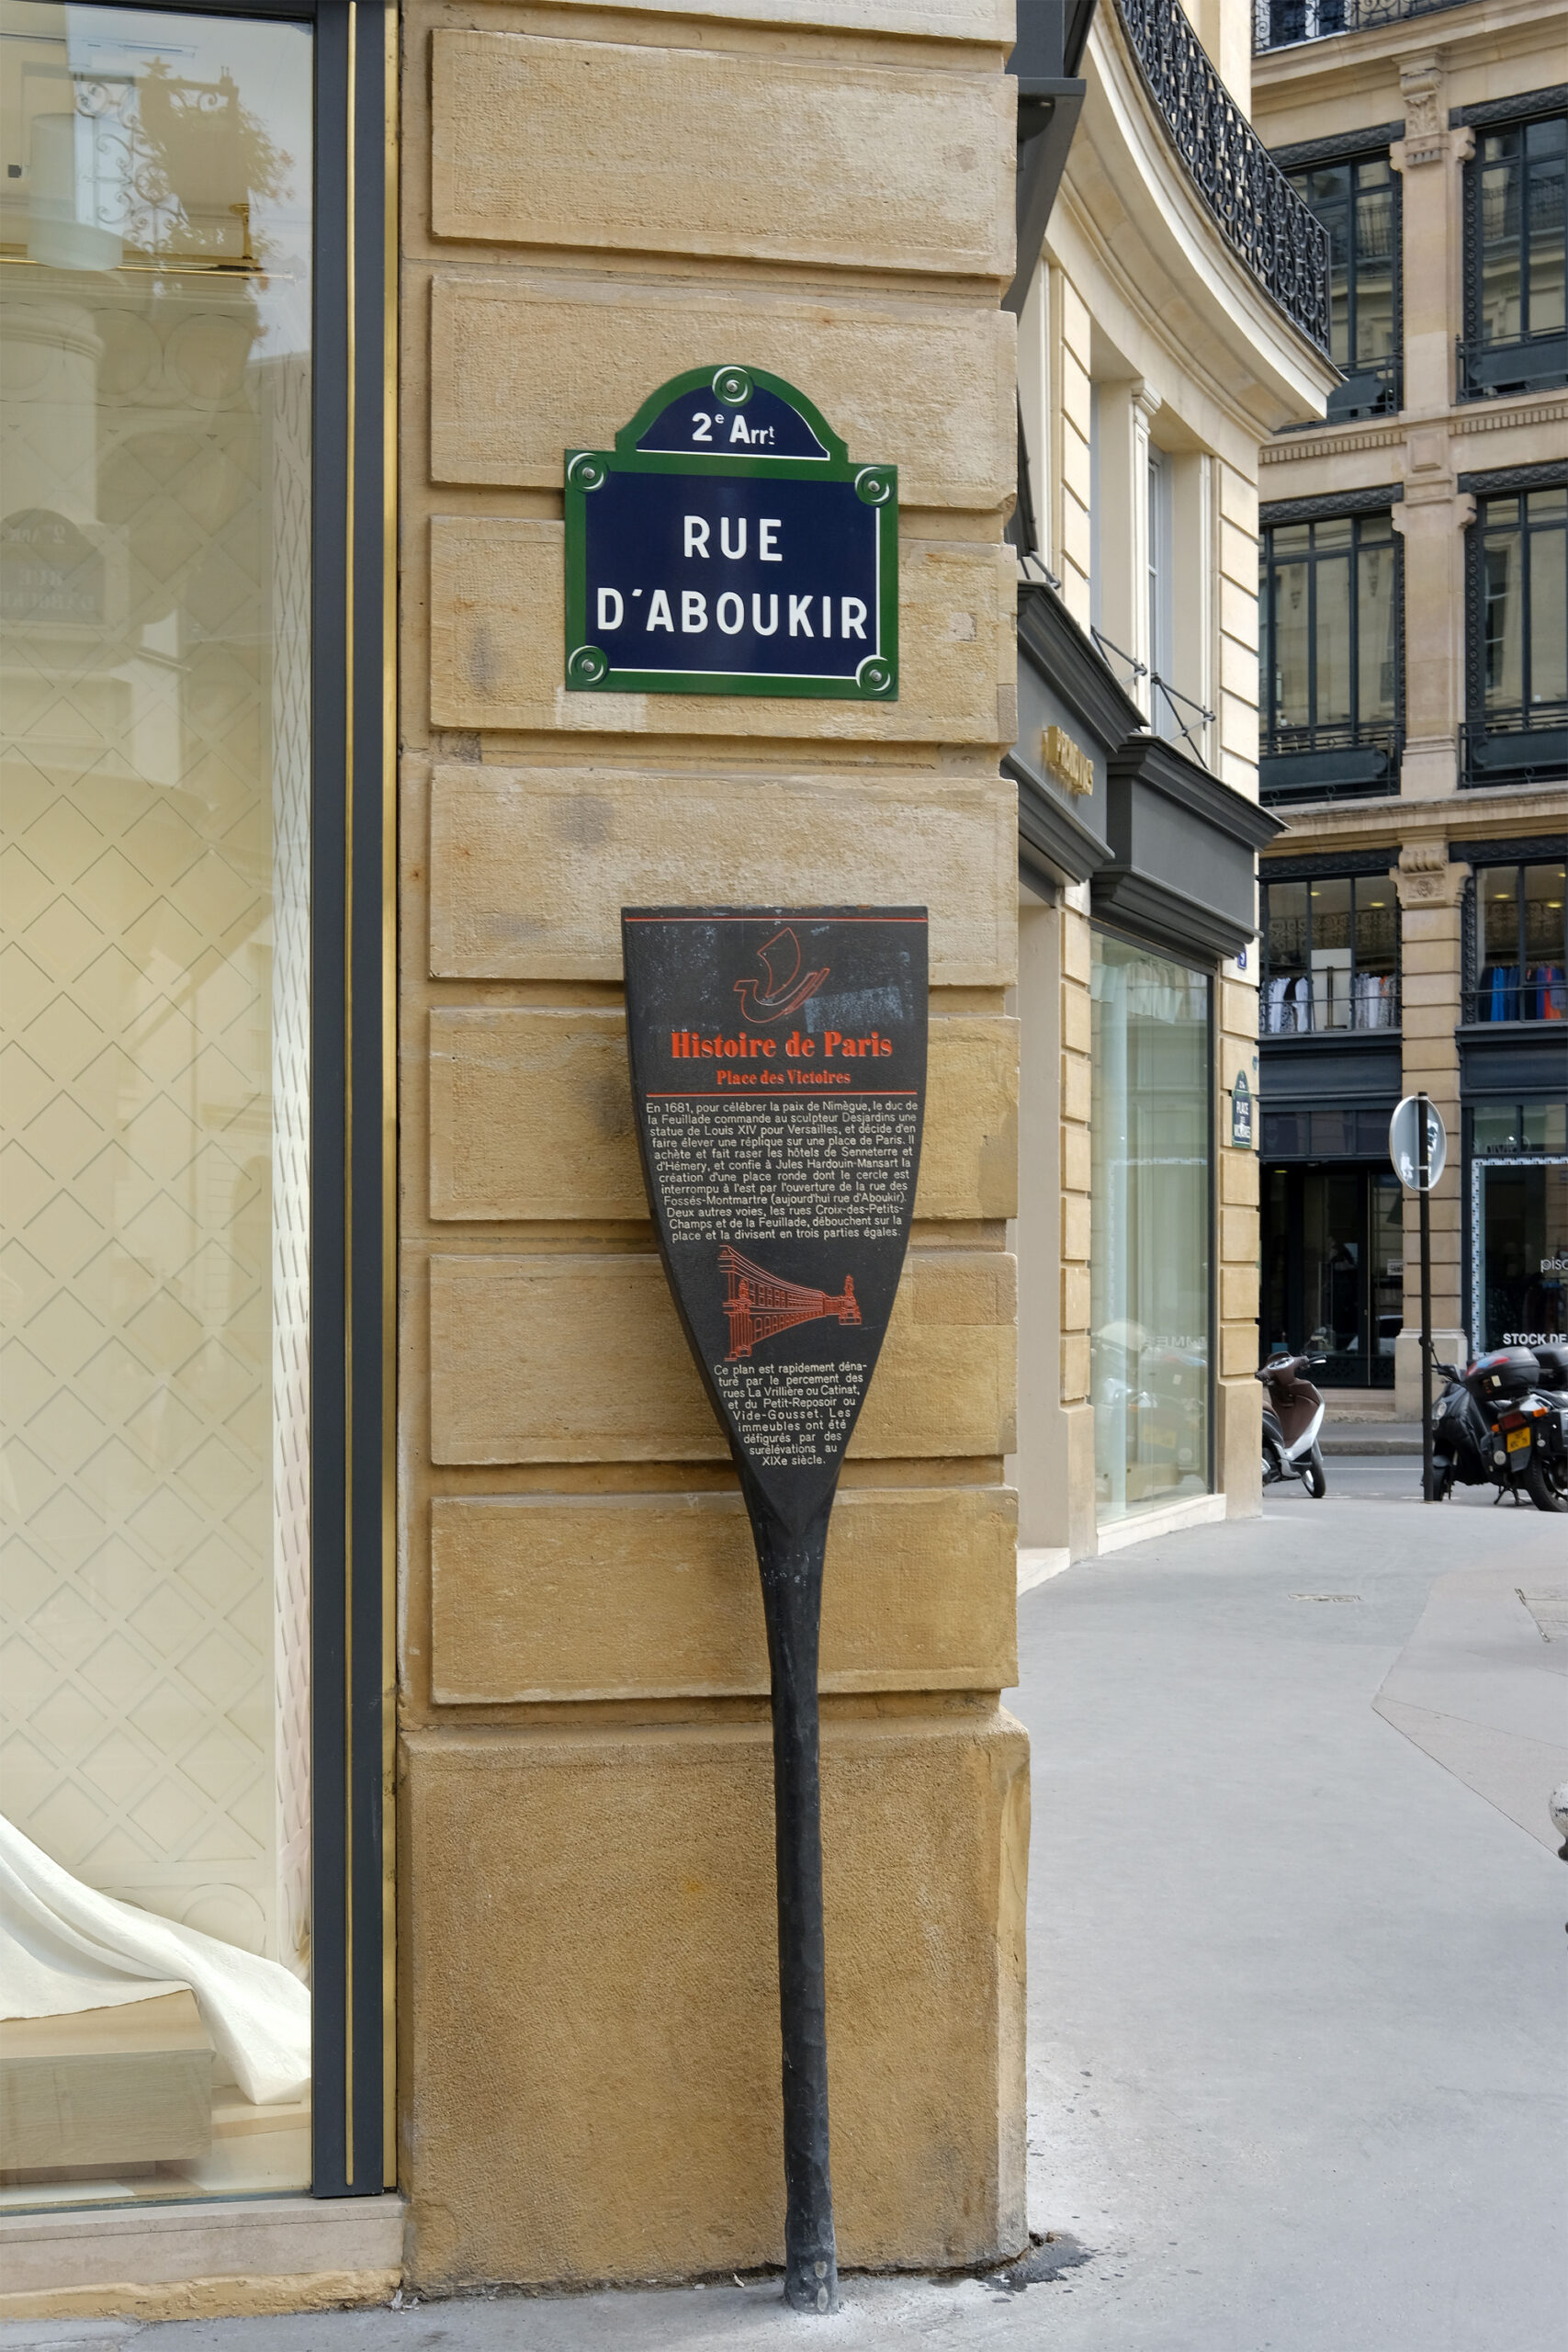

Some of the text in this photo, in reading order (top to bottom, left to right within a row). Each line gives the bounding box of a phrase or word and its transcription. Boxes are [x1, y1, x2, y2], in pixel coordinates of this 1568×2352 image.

[682, 515, 783, 562] RUE
[597, 587, 868, 639] D'ABOUKIR
[671, 1030, 893, 1057] Histoire de Paris
[716, 1069, 851, 1085] Place des Victoires
[646, 1100, 919, 1114] En 1681, pour célébrer la paix de Nimègue, le duc de
[648, 1112, 917, 1125] la Feuillade commande au sculpteur Desjardins une
[649, 1123, 916, 1137] statue de Louis XIV pour Versailles, et décide d'en
[651, 1134, 915, 1149] faire élever une réplique sur une place de Paris. Il
[653, 1146, 913, 1159] achète et fait raser les hôtels de Senneterre et
[656, 1157, 911, 1173] d'Hémery, et confie à Jules Hardouin-Mansart la
[659, 1169, 909, 1184] création d'une place ronde dont le cercle est
[660, 1180, 908, 1196] interrompu à l'est par l'ouverture de la rue des
[663, 1193, 768, 1206] Fossés-Montmartre
[770, 1193, 830, 1206] (aujourd'hui
[833, 1194, 850, 1203] rue
[666, 1203, 904, 1217] Deux autres voies, les rues Croix-des-Petits-
[669, 1215, 902, 1231] Champs et de la Feuillade, débouchent sur la
[671, 1226, 900, 1243] place et la divisent en trois parties égales.
[1502, 1333, 1547, 1345] STOCK
[714, 1361, 867, 1377] Ce plan est rapidement déna-
[718, 1372, 863, 1388] turé par le percement des
[723, 1384, 860, 1398] rues La Vrillière ou Catinat,
[728, 1396, 855, 1411] et du Petit-Reposoir ou
[733, 1407, 851, 1420] Vide-Gousset. Les
[738, 1419, 846, 1432] immeubles ont été
[743, 1430, 841, 1446] défigurés par des
[749, 1442, 837, 1455] surélévations au
[761, 1453, 826, 1465] XIXe siècle.
